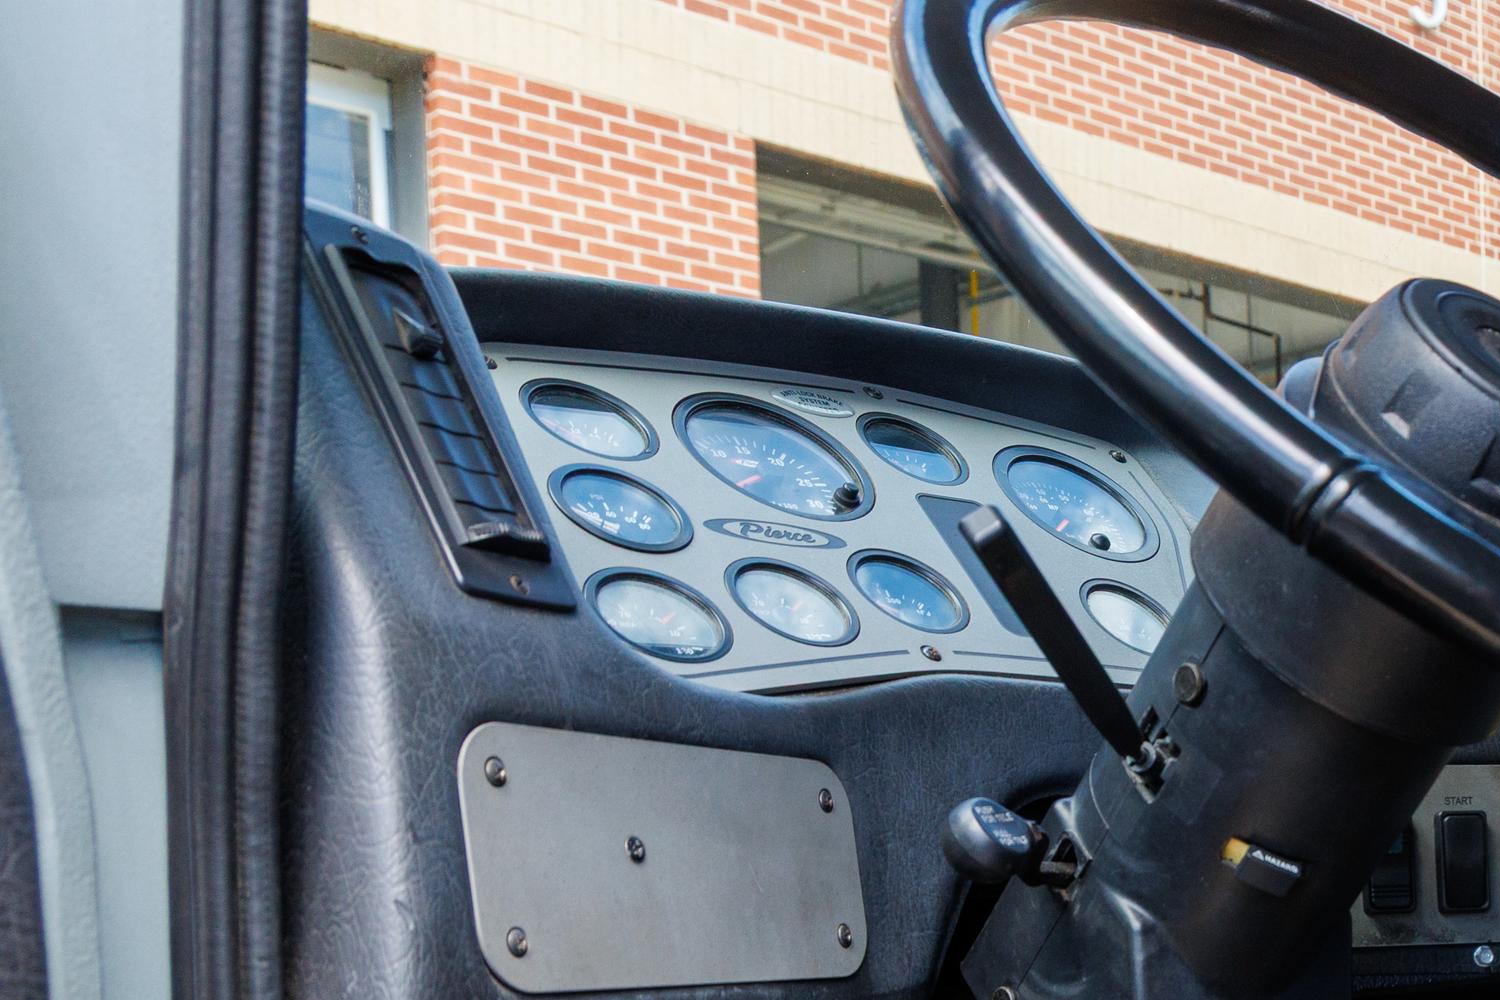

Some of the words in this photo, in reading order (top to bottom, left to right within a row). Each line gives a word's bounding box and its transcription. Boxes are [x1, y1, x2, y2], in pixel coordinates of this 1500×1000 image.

[710, 448, 727, 458] 10
[735, 445, 751, 455] 15
[767, 457, 785, 467] 20
[796, 478, 813, 488] 25
[806, 499, 824, 509] 30
[739, 521, 816, 544] Pierce
[1444, 796, 1473, 806] START
[1264, 854, 1299, 874] HAZARD
